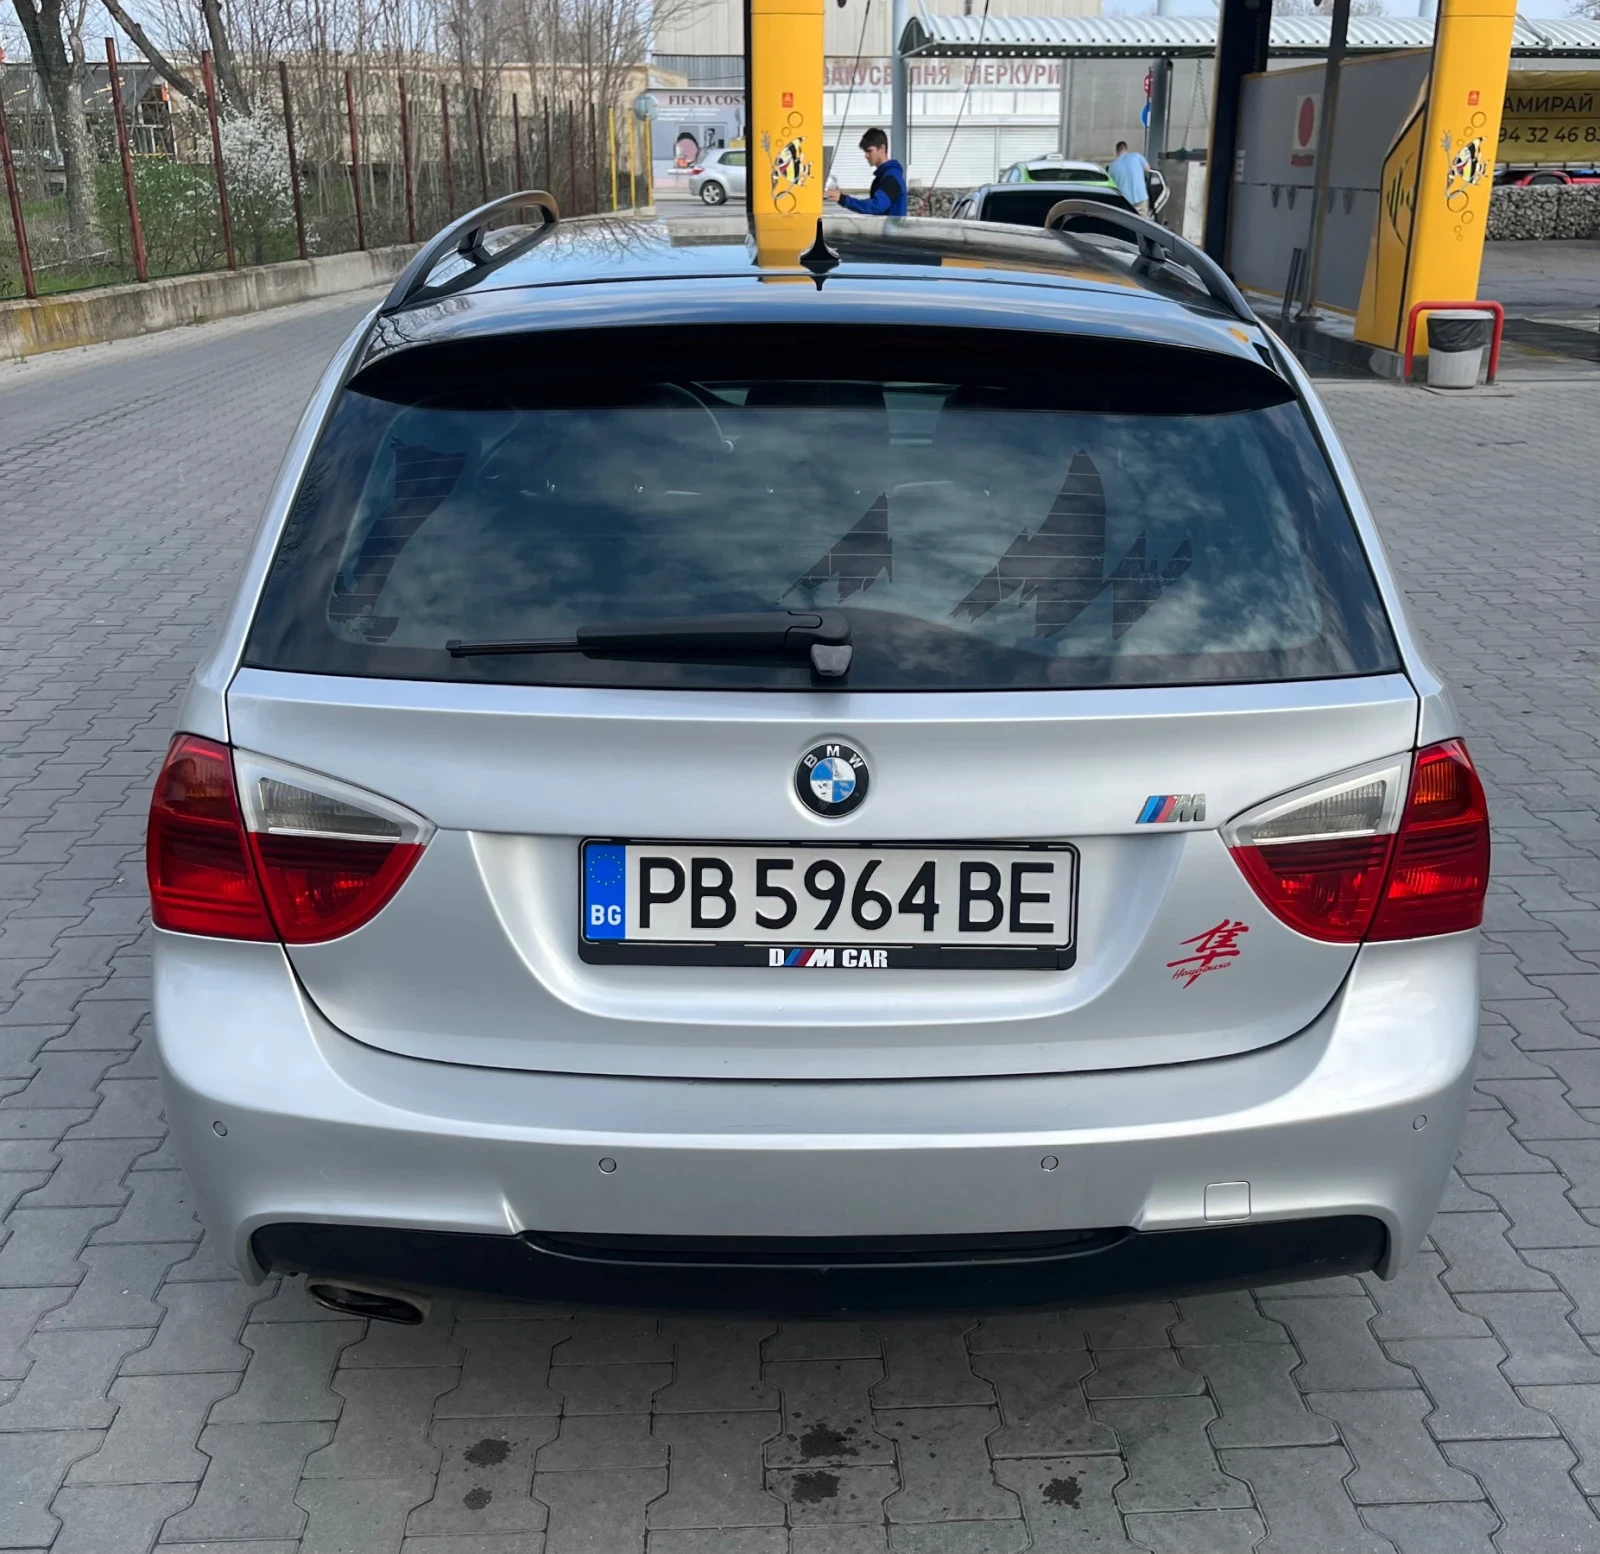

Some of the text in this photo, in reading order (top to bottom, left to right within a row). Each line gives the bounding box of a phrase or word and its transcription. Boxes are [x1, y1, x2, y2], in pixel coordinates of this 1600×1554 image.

[668, 95, 712, 106] FIESTA
[1525, 126, 1549, 143] 32
[1553, 126, 1579, 143] 46
[803, 745, 864, 769] BMW
[639, 856, 1055, 934] PB 5964 BE
[591, 904, 622, 926] BG
[842, 949, 888, 968] CAR
